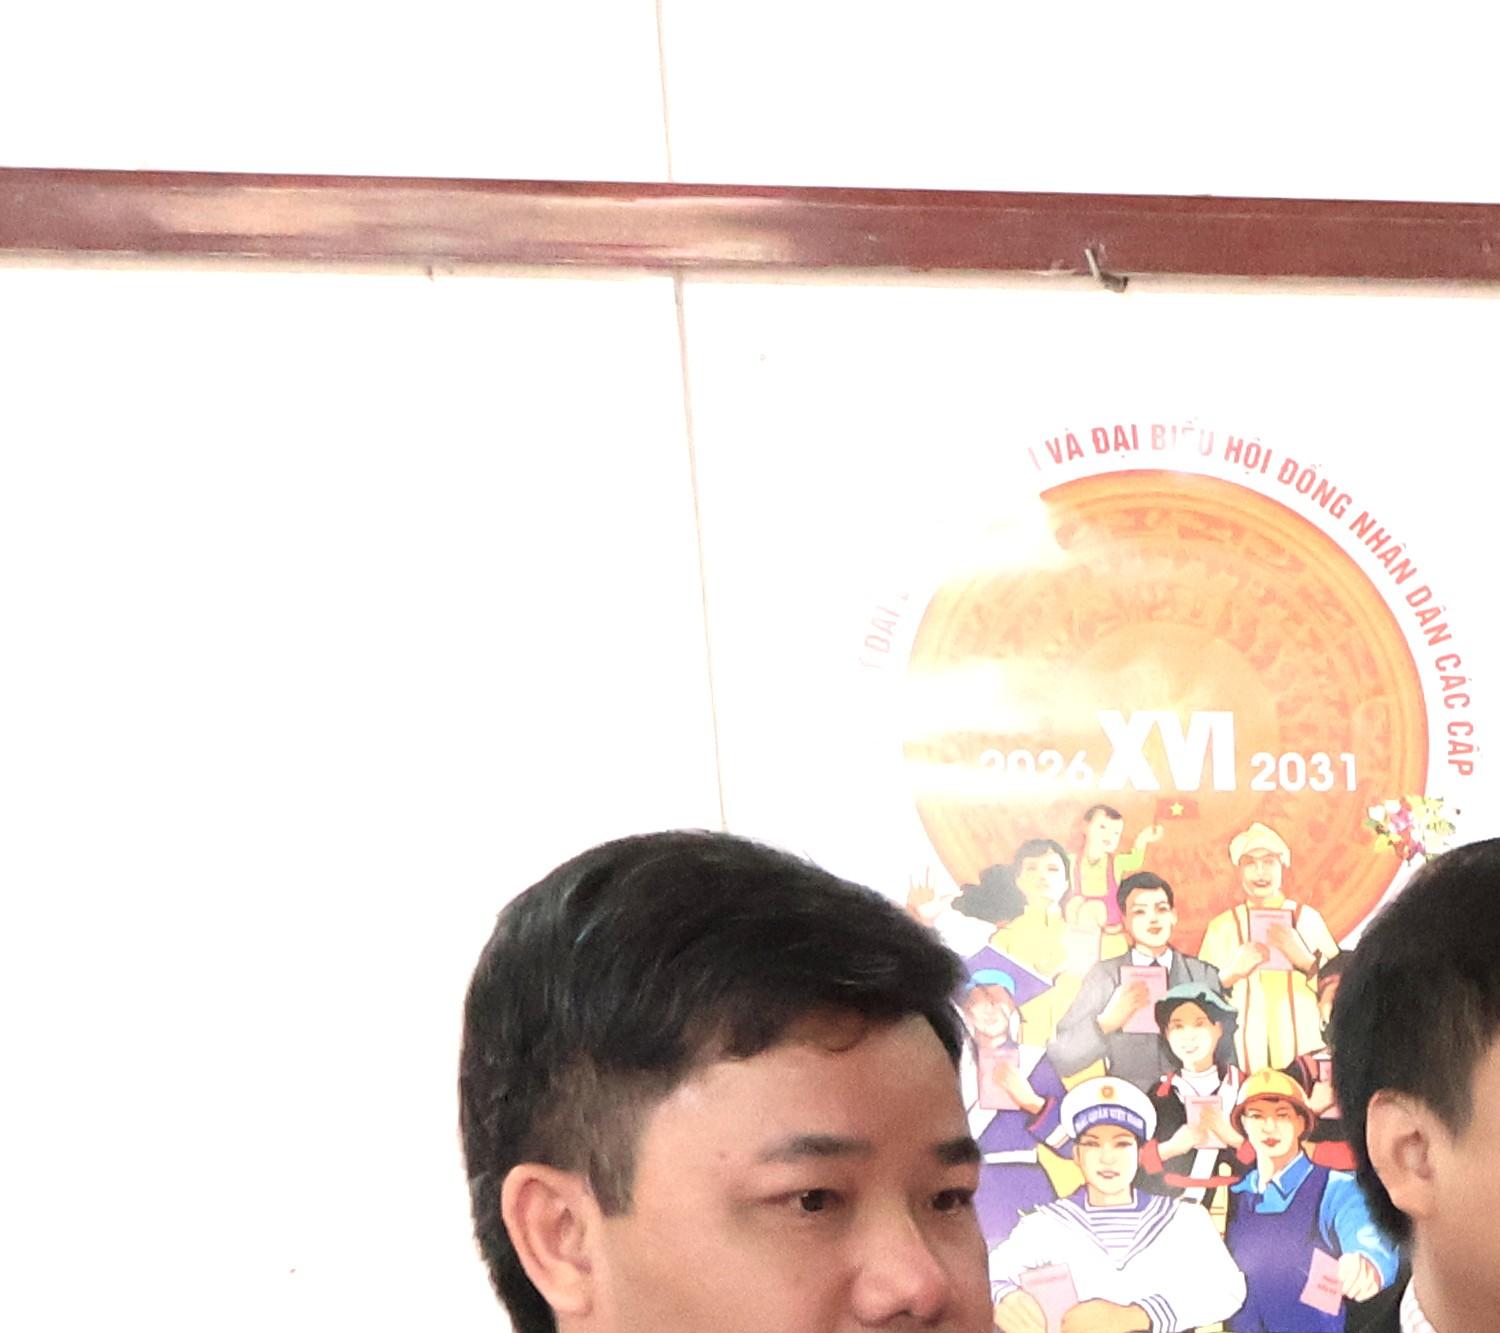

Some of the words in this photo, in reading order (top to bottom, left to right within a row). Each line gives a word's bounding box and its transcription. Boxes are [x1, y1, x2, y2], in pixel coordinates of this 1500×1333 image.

[1045, 427, 1084, 464] VÀ
[1091, 424, 1139, 458] ĐẠI
[1224, 435, 1272, 475] HỘI
[1349, 510, 1418, 585] NHÂN
[1405, 585, 1453, 647] DÂN
[1435, 653, 1473, 710] CÁC
[1100, 710, 1237, 793] XVI
[1250, 751, 1358, 792] 2031
